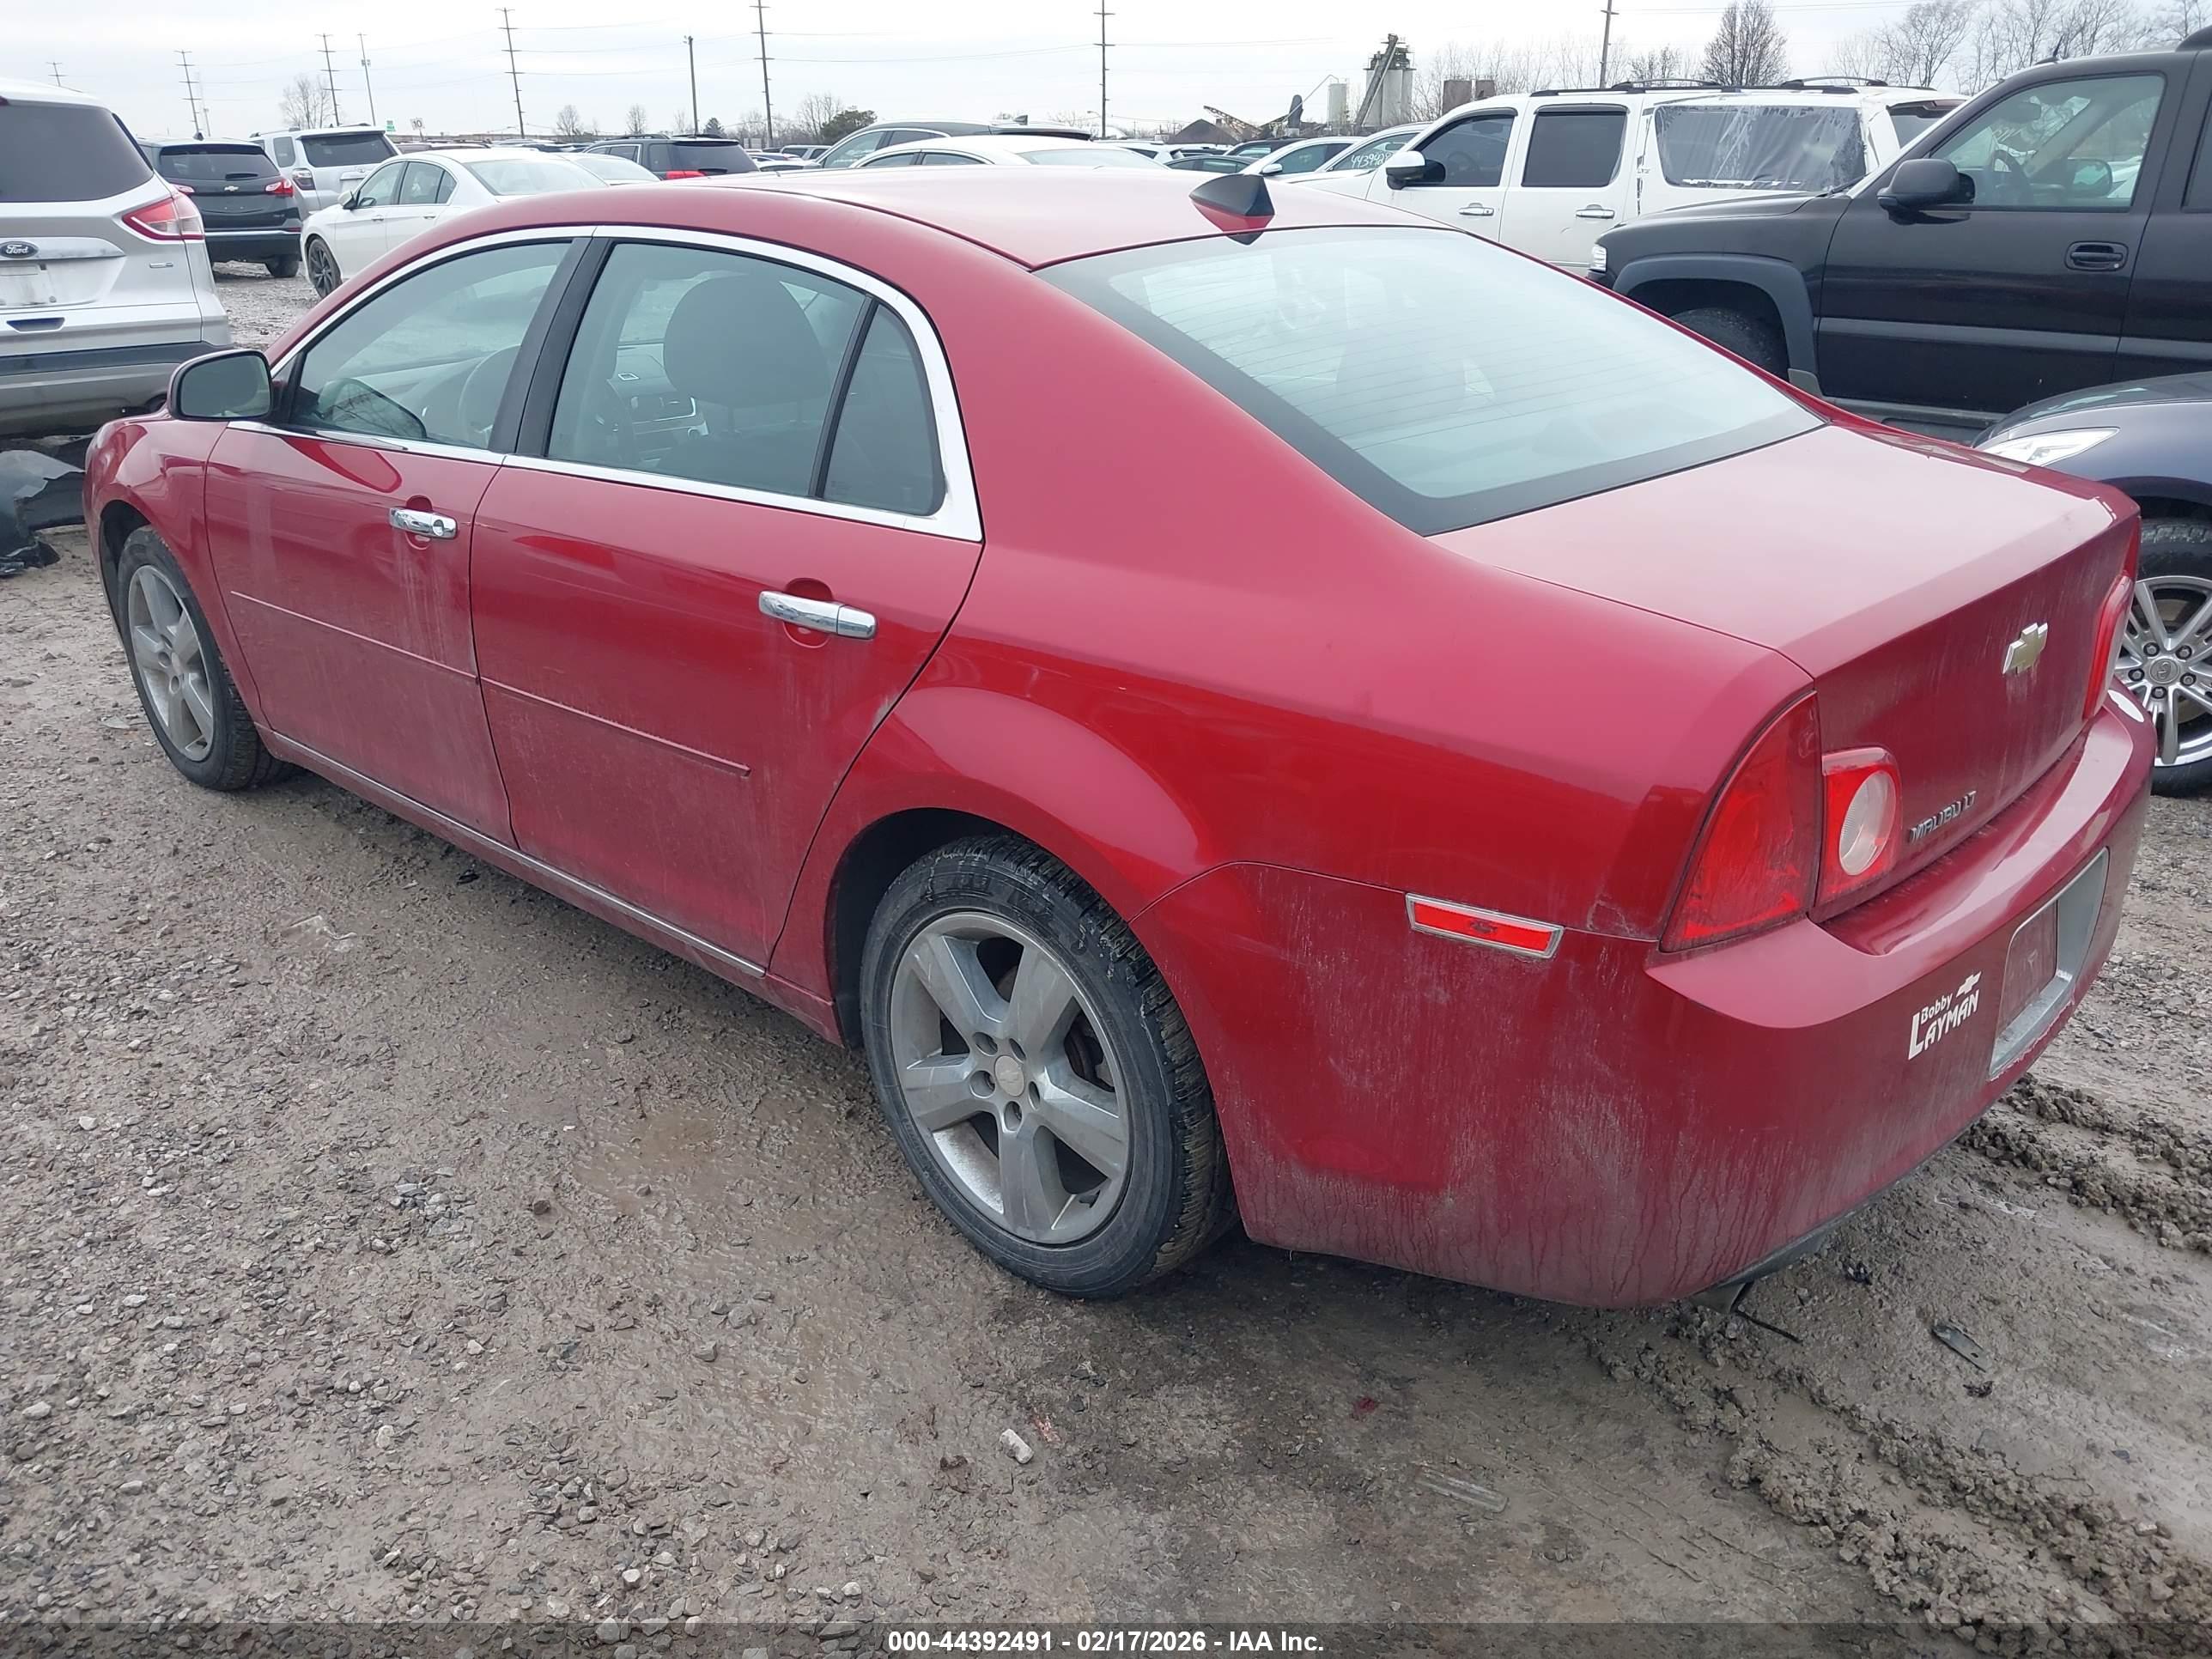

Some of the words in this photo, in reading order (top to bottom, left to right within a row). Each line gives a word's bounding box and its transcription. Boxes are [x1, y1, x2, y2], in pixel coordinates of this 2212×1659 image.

[6, 244, 28, 254] Ford
[1908, 800, 1962, 845] MALIBU
[1963, 790, 1977, 810] LT
[1908, 988, 1980, 1060] LAYMAN
[1920, 993, 1954, 1024] Bobby
